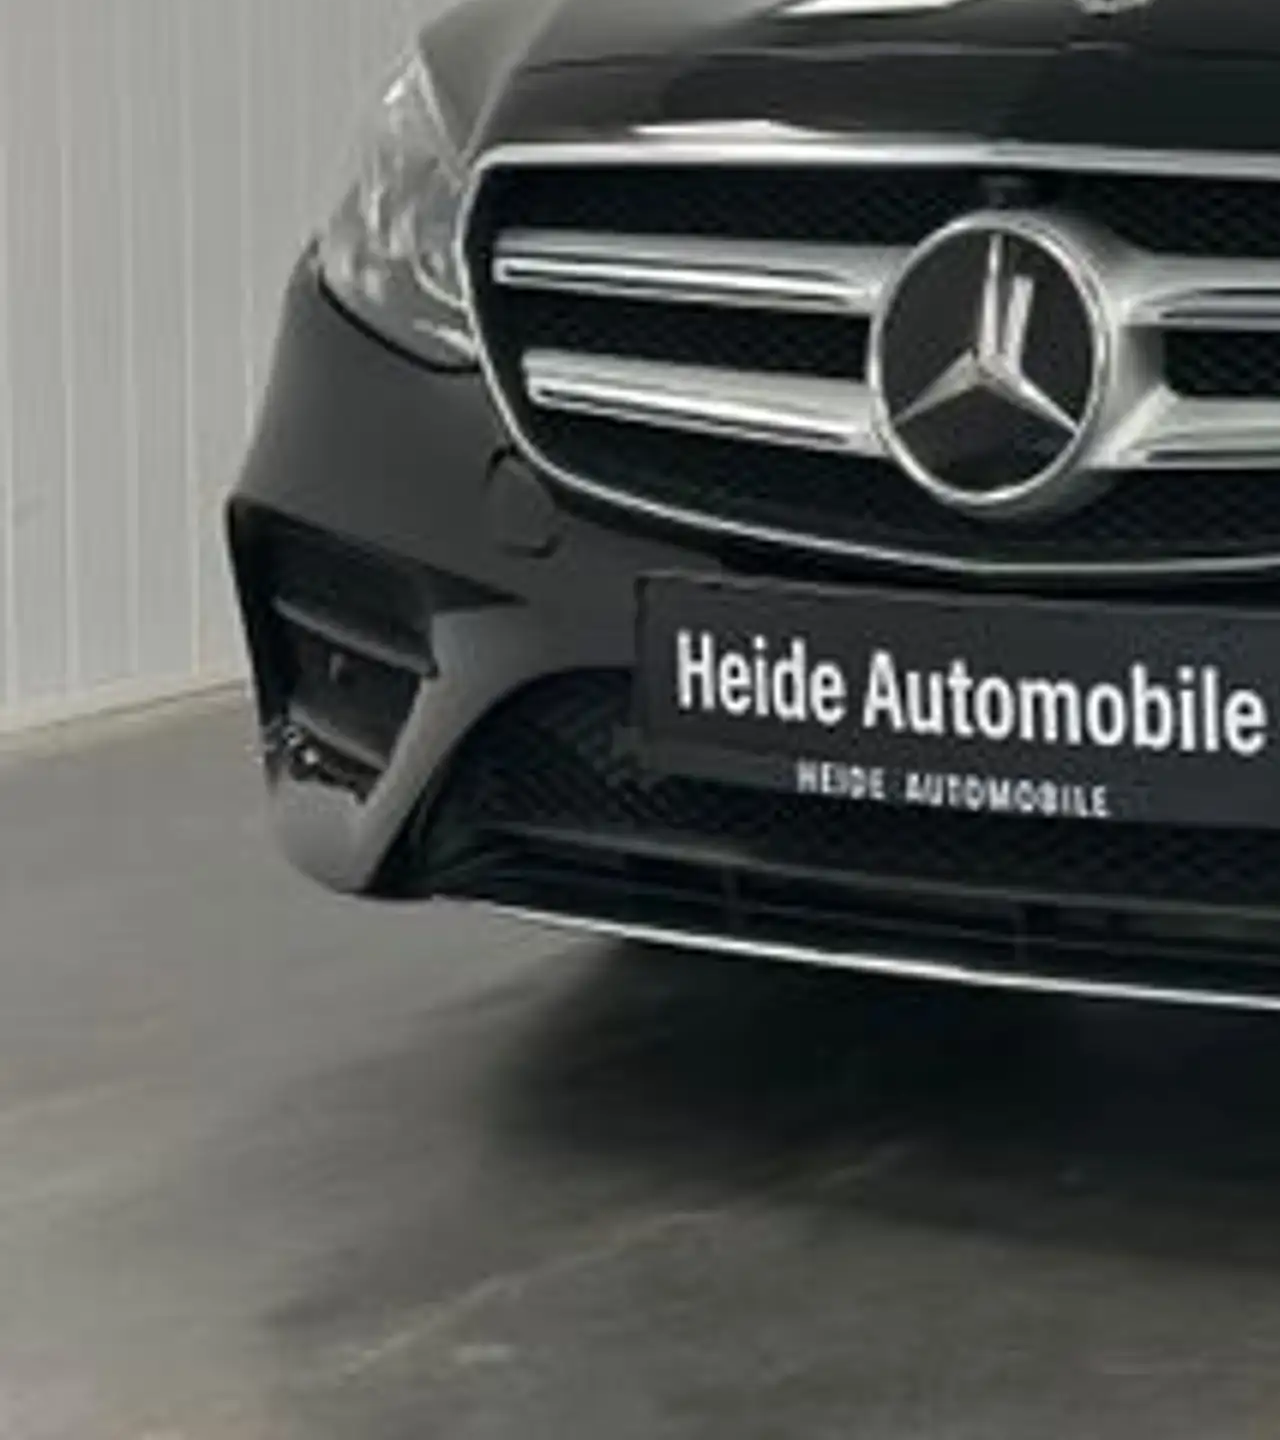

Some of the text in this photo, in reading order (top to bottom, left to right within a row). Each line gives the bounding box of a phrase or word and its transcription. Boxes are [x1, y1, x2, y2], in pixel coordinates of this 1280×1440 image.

[676, 629, 1268, 757] Heide Automobile
[796, 760, 1111, 819] HEIDE AUTOMOBILE
